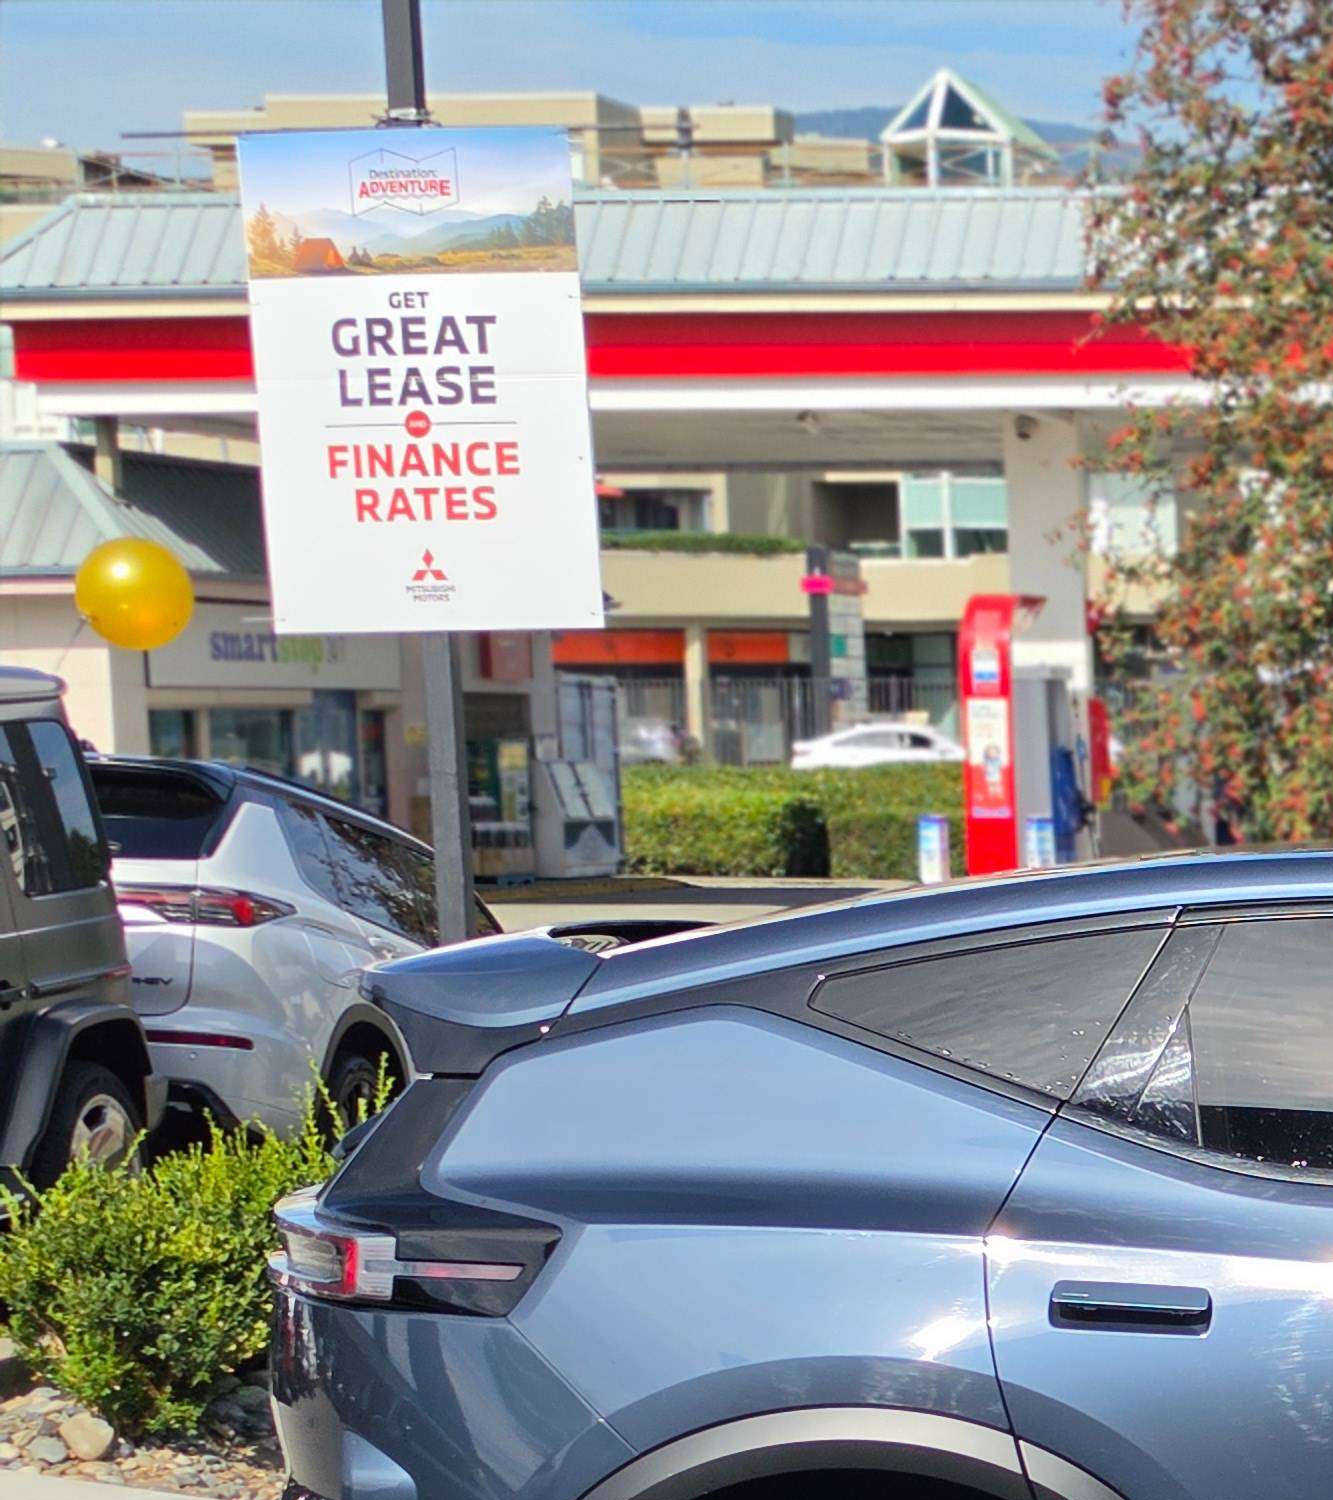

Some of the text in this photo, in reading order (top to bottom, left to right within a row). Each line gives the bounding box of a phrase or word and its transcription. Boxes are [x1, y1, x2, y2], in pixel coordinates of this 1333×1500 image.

[359, 179, 451, 198] ADVENTURE
[388, 291, 430, 309] GET
[331, 315, 498, 358] GREAT
[337, 366, 498, 408] LEASE
[327, 442, 521, 480] FINANCE
[354, 486, 498, 523] RATES
